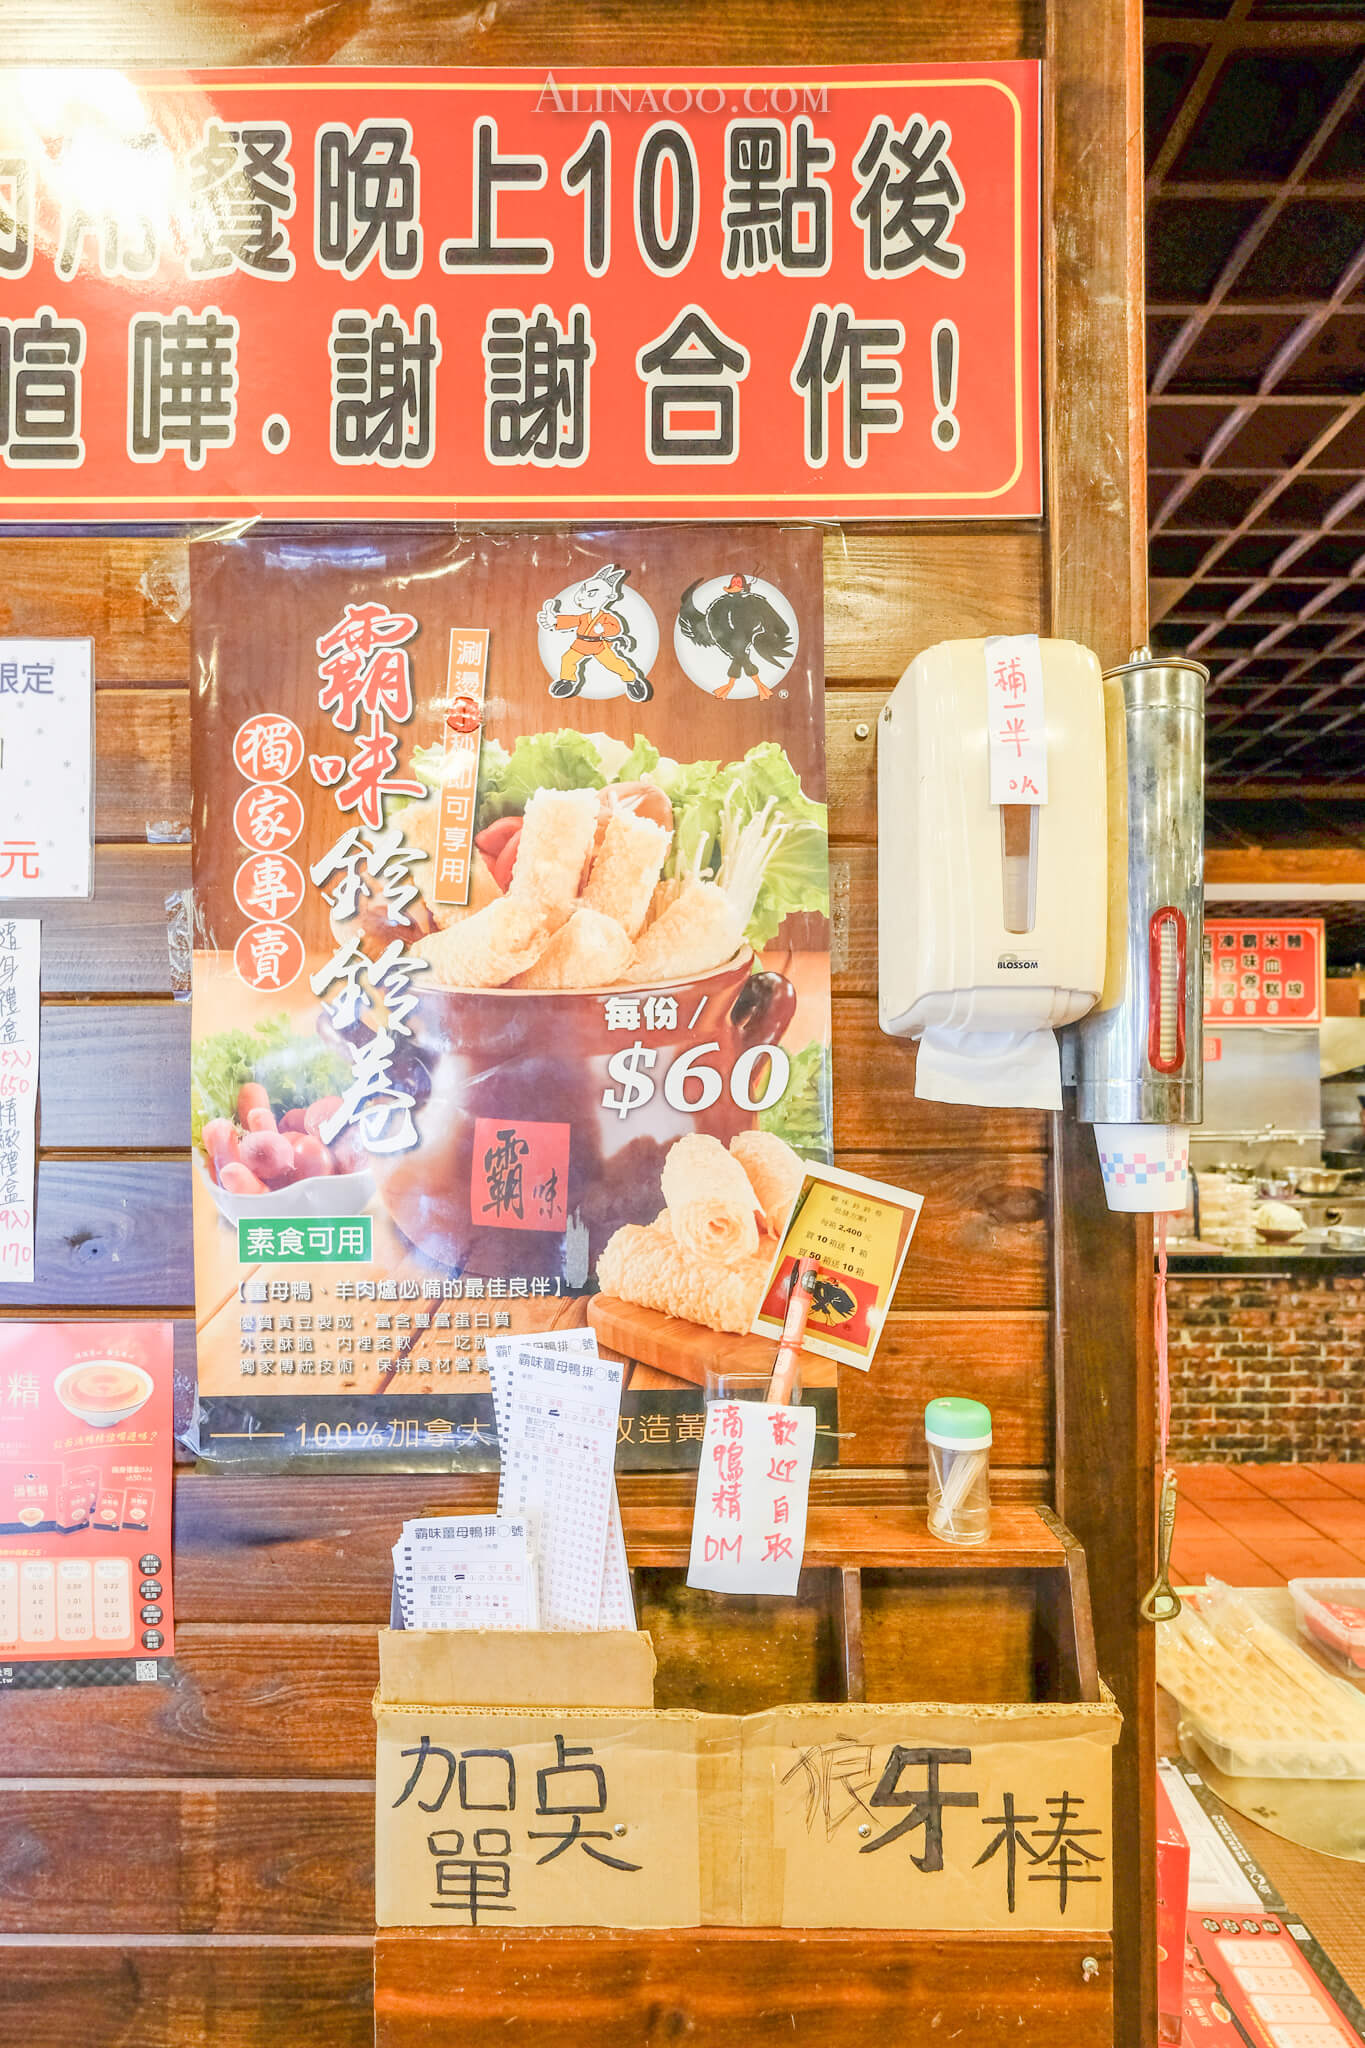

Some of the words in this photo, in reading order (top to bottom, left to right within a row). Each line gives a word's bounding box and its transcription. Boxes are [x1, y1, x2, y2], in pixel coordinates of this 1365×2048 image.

[0, 841, 39, 879] 元
[240, 722, 298, 988] 獨家專賣
[997, 961, 1039, 970] BLOSSOM
[602, 1041, 790, 1120] $60
[247, 1227, 365, 1257] 素食可用
[817, 1235, 828, 1244] 10
[809, 1251, 822, 1261] 50
[842, 1263, 855, 1273] 10
[0, 1368, 40, 1410] 精
[704, 1534, 743, 1564] DM
